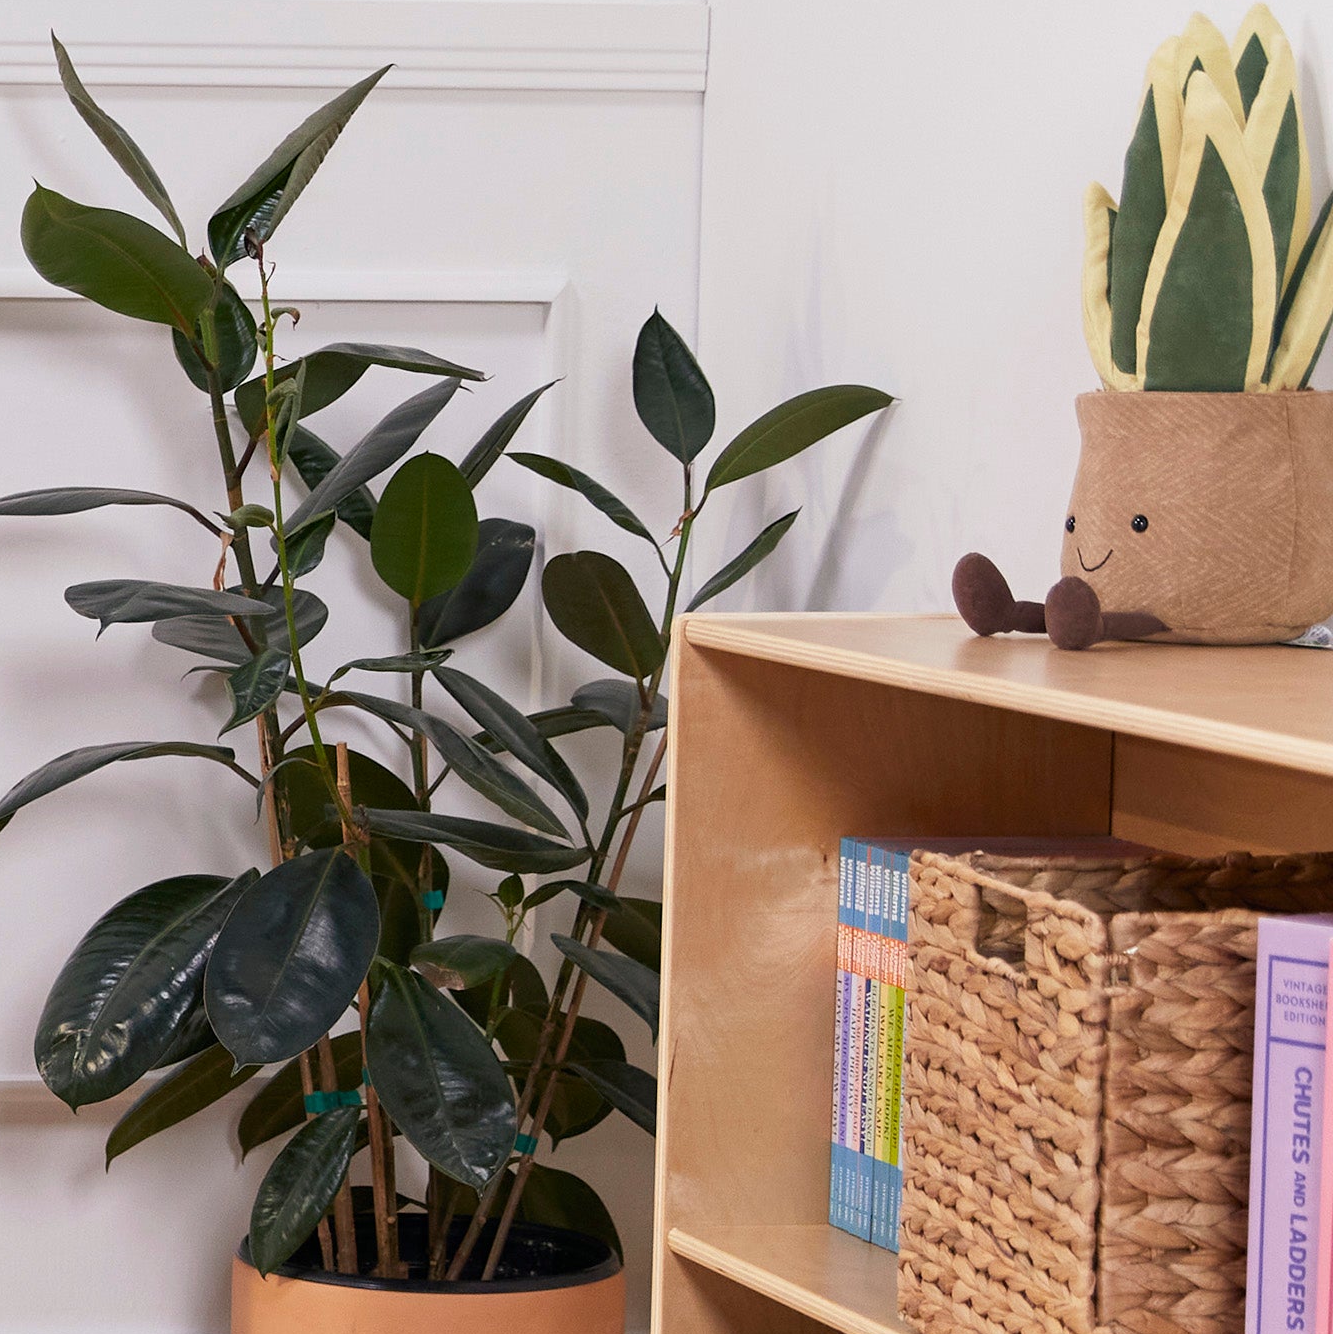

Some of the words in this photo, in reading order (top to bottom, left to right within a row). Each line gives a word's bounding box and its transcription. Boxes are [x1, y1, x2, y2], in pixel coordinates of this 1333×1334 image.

[859, 862, 867, 912] Willems
[874, 865, 882, 916] Willems
[892, 870, 900, 922] Willems
[1283, 979, 1327, 995] VINTAGE
[863, 992, 871, 1049] WAITING
[889, 1009, 894, 1030] WE
[1284, 1011, 1325, 1027] EDITION
[1292, 1066, 1313, 1164] CHUTES
[1293, 1170, 1306, 1207] AND
[1286, 1213, 1308, 1331] LADDERS
